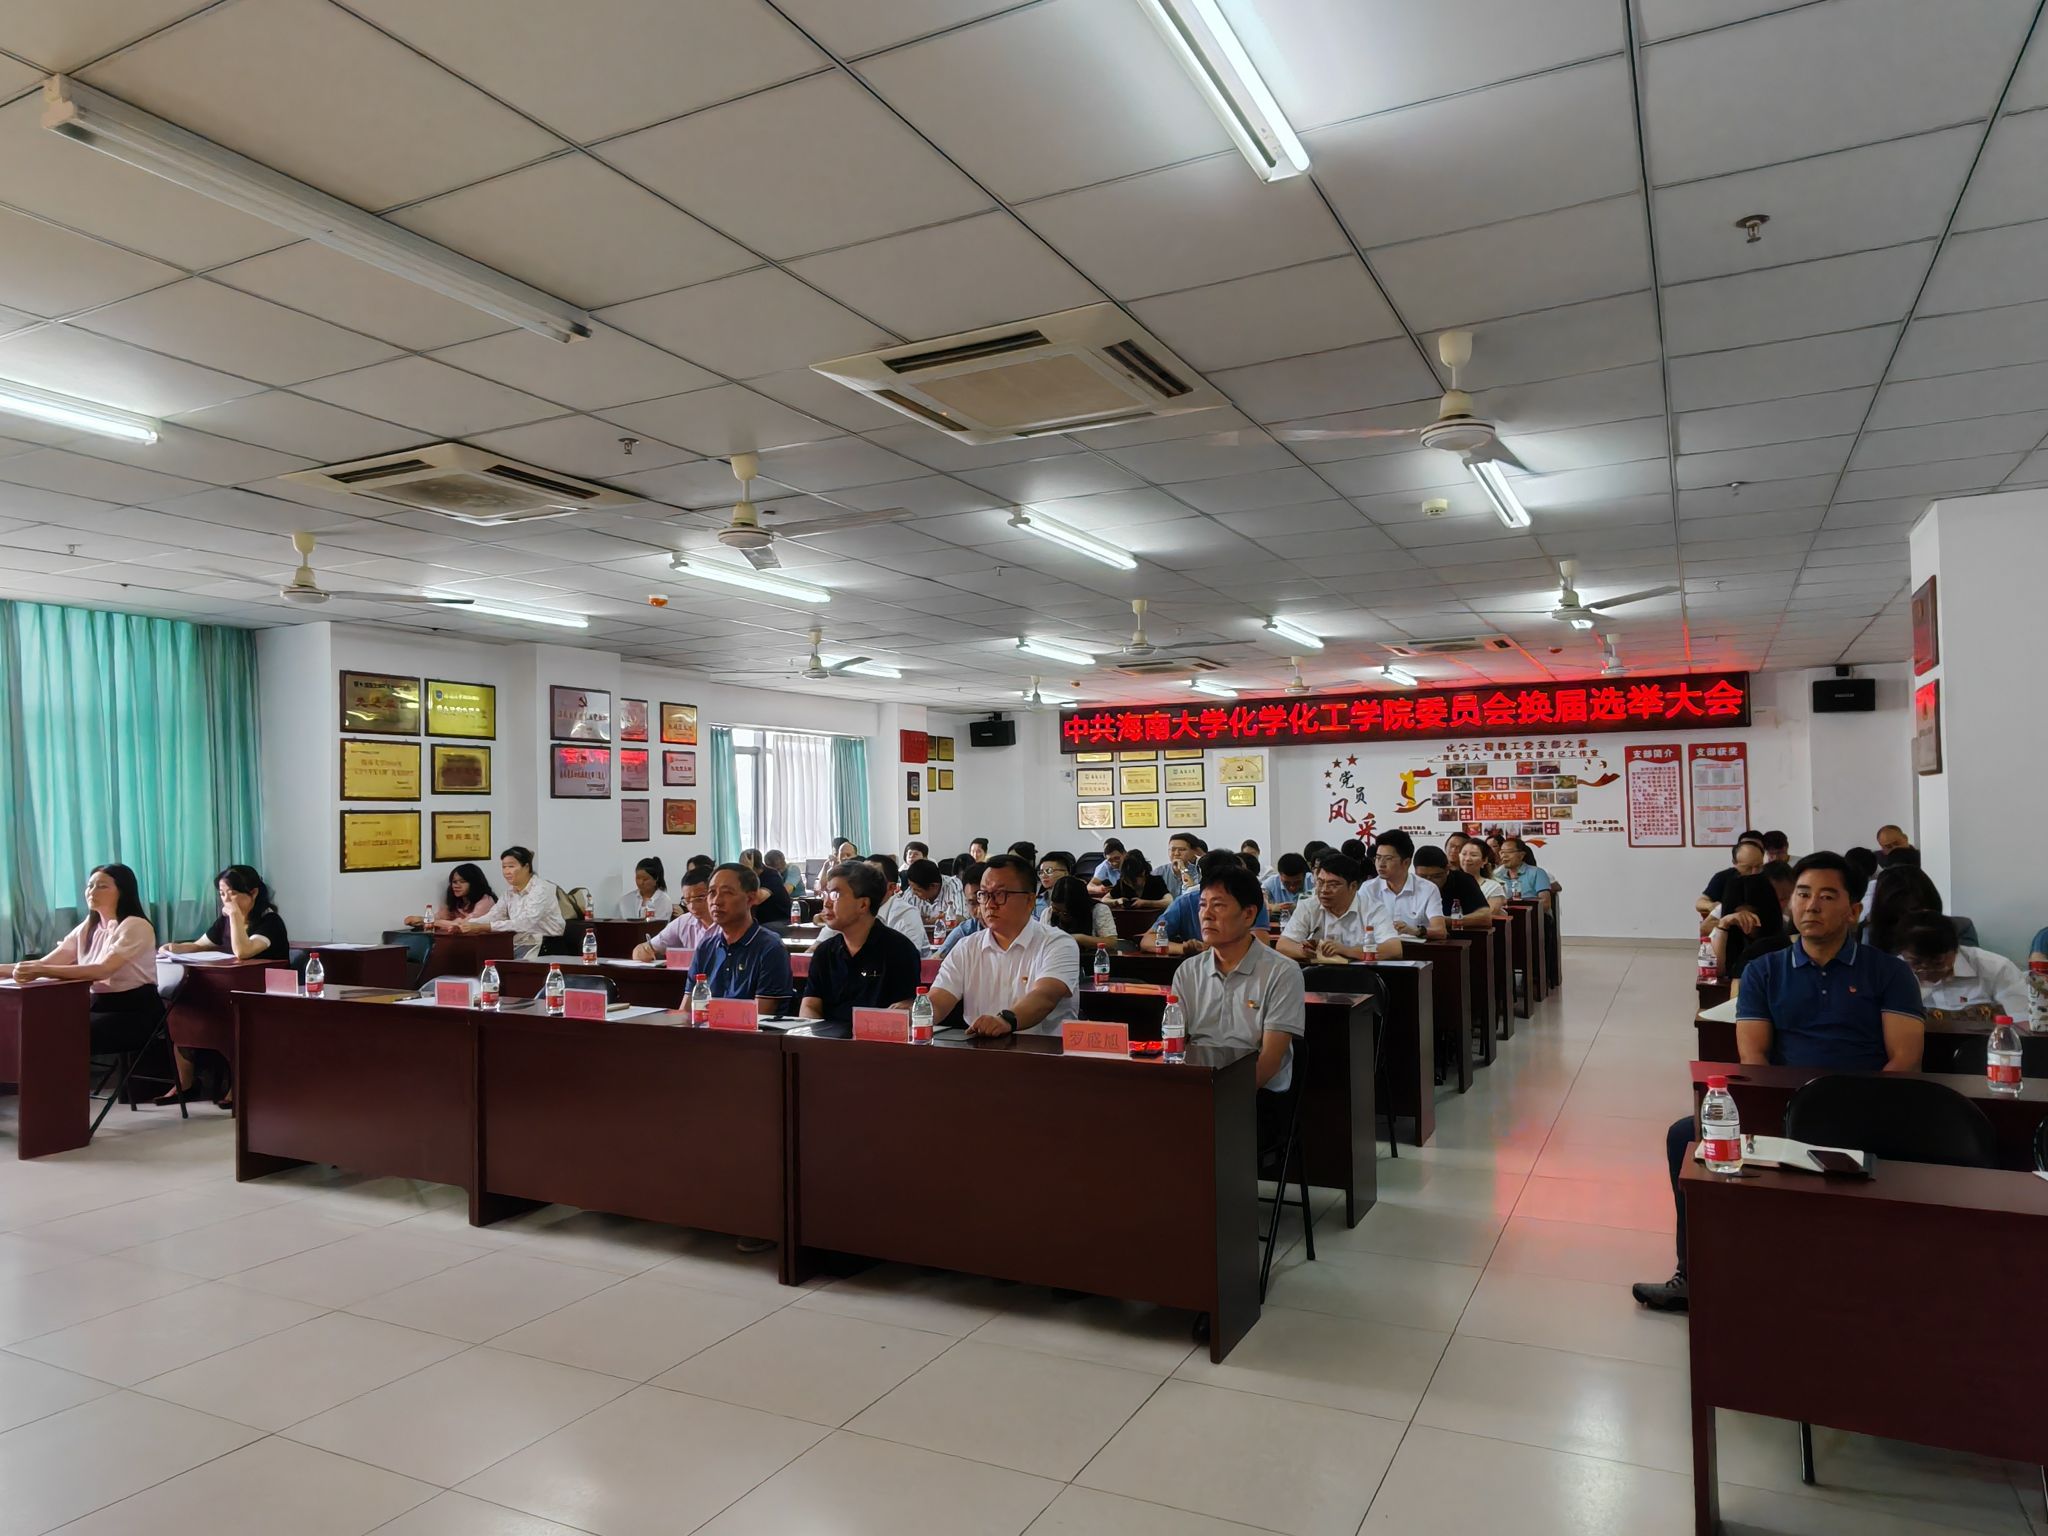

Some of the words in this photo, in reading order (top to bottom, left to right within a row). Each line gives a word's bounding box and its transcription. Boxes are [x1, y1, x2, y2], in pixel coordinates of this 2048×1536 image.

[1063, 680, 1744, 745] 中共海南大学化学化工学院委员会换届选举大会
[1632, 749, 1675, 759] 支部简介
